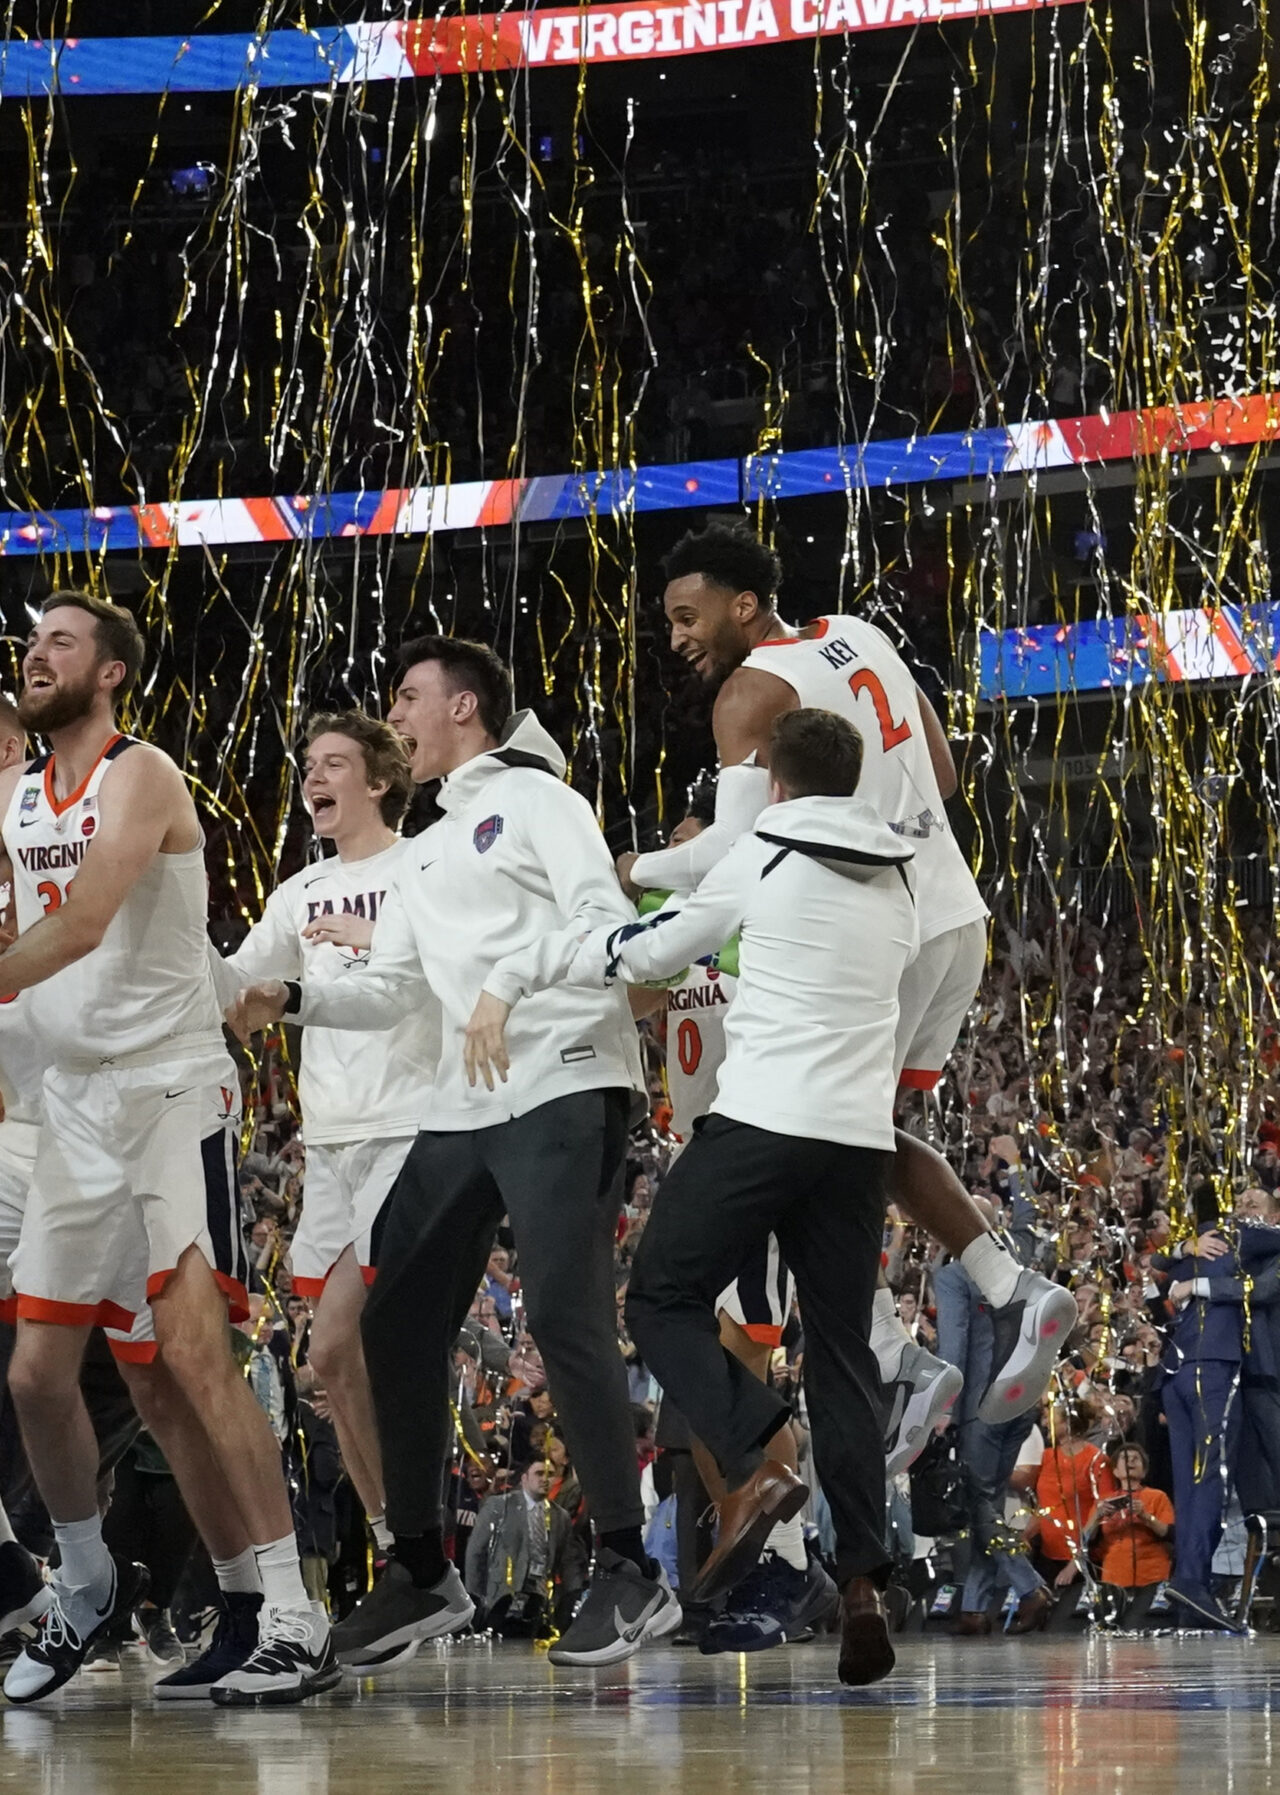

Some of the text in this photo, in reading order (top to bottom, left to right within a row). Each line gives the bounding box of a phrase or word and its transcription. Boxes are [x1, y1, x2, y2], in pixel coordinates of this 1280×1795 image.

[518, 0, 780, 62] VIRGINIA
[818, 637, 859, 670] KEY
[848, 668, 912, 753] 2
[17, 839, 92, 871] VIRGINI
[667, 983, 728, 1011] RGINIA
[677, 1018, 702, 1076] 0
